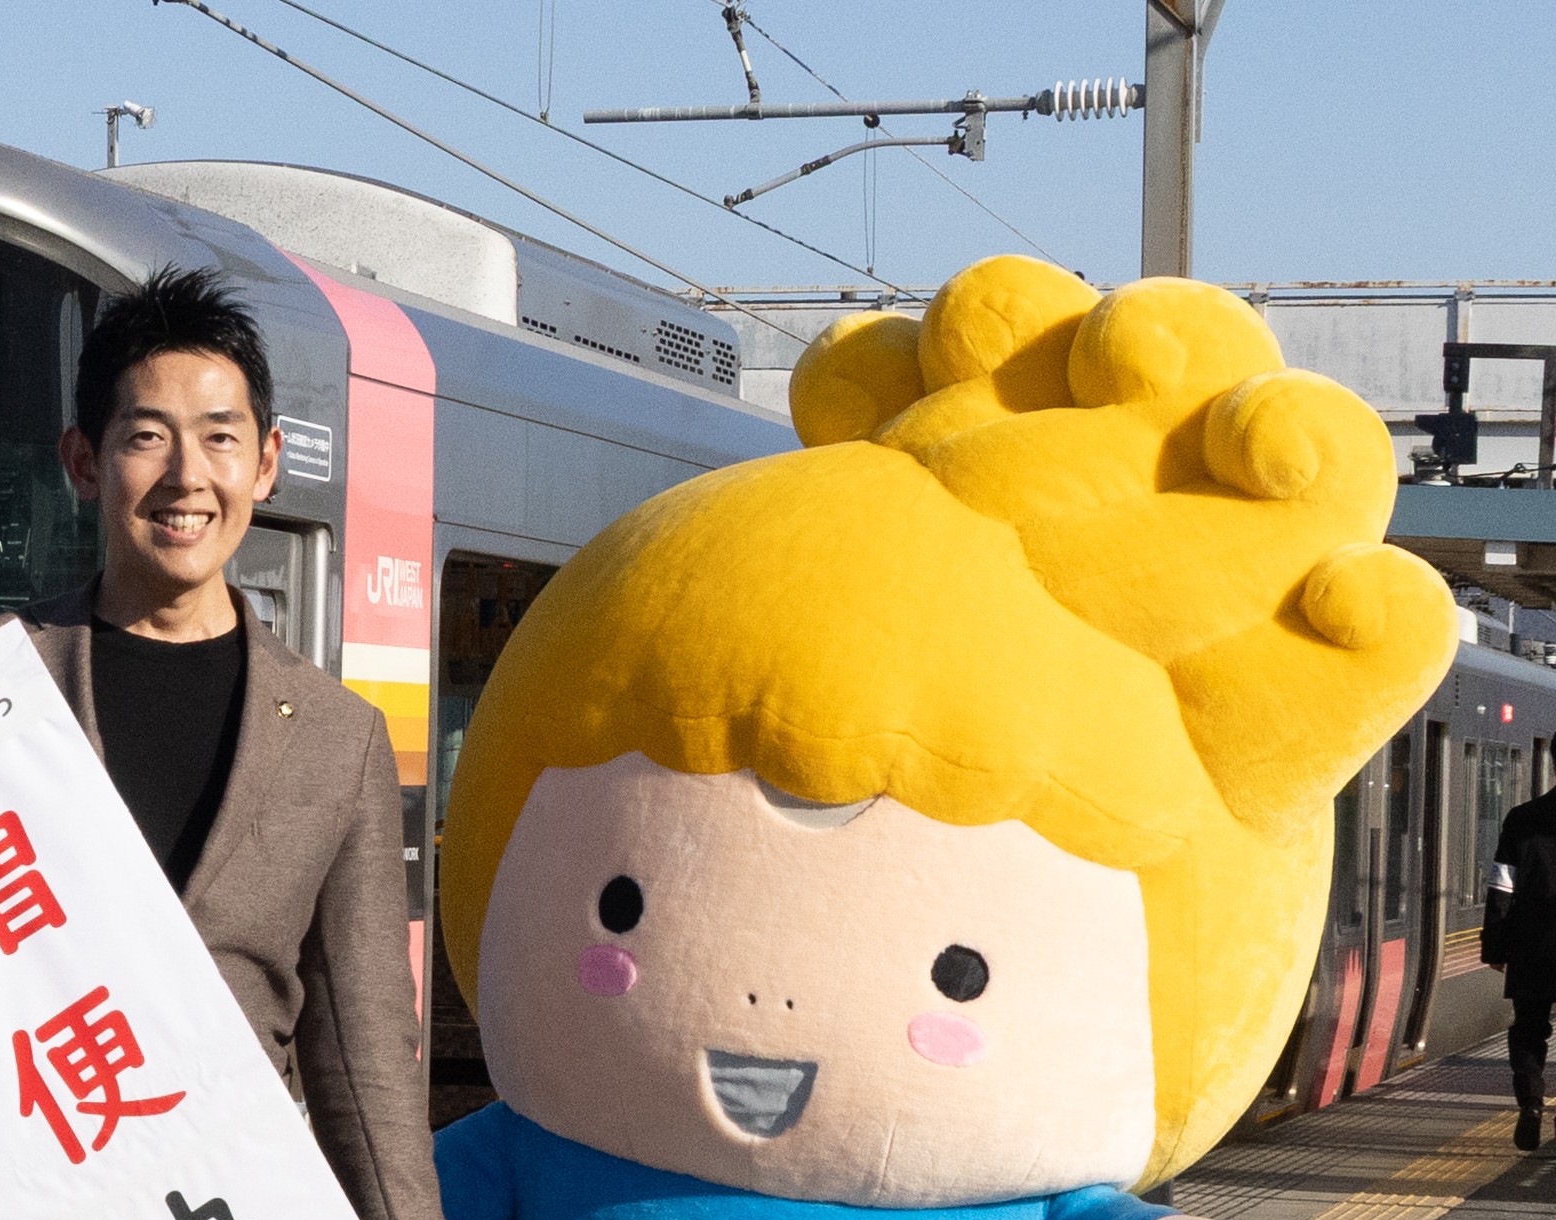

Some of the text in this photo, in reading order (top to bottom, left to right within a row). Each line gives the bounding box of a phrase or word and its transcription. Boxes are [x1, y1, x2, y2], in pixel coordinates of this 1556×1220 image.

[366, 555, 393, 606] JR
[399, 559, 422, 584] WEST
[398, 585, 423, 609] JAPAN
